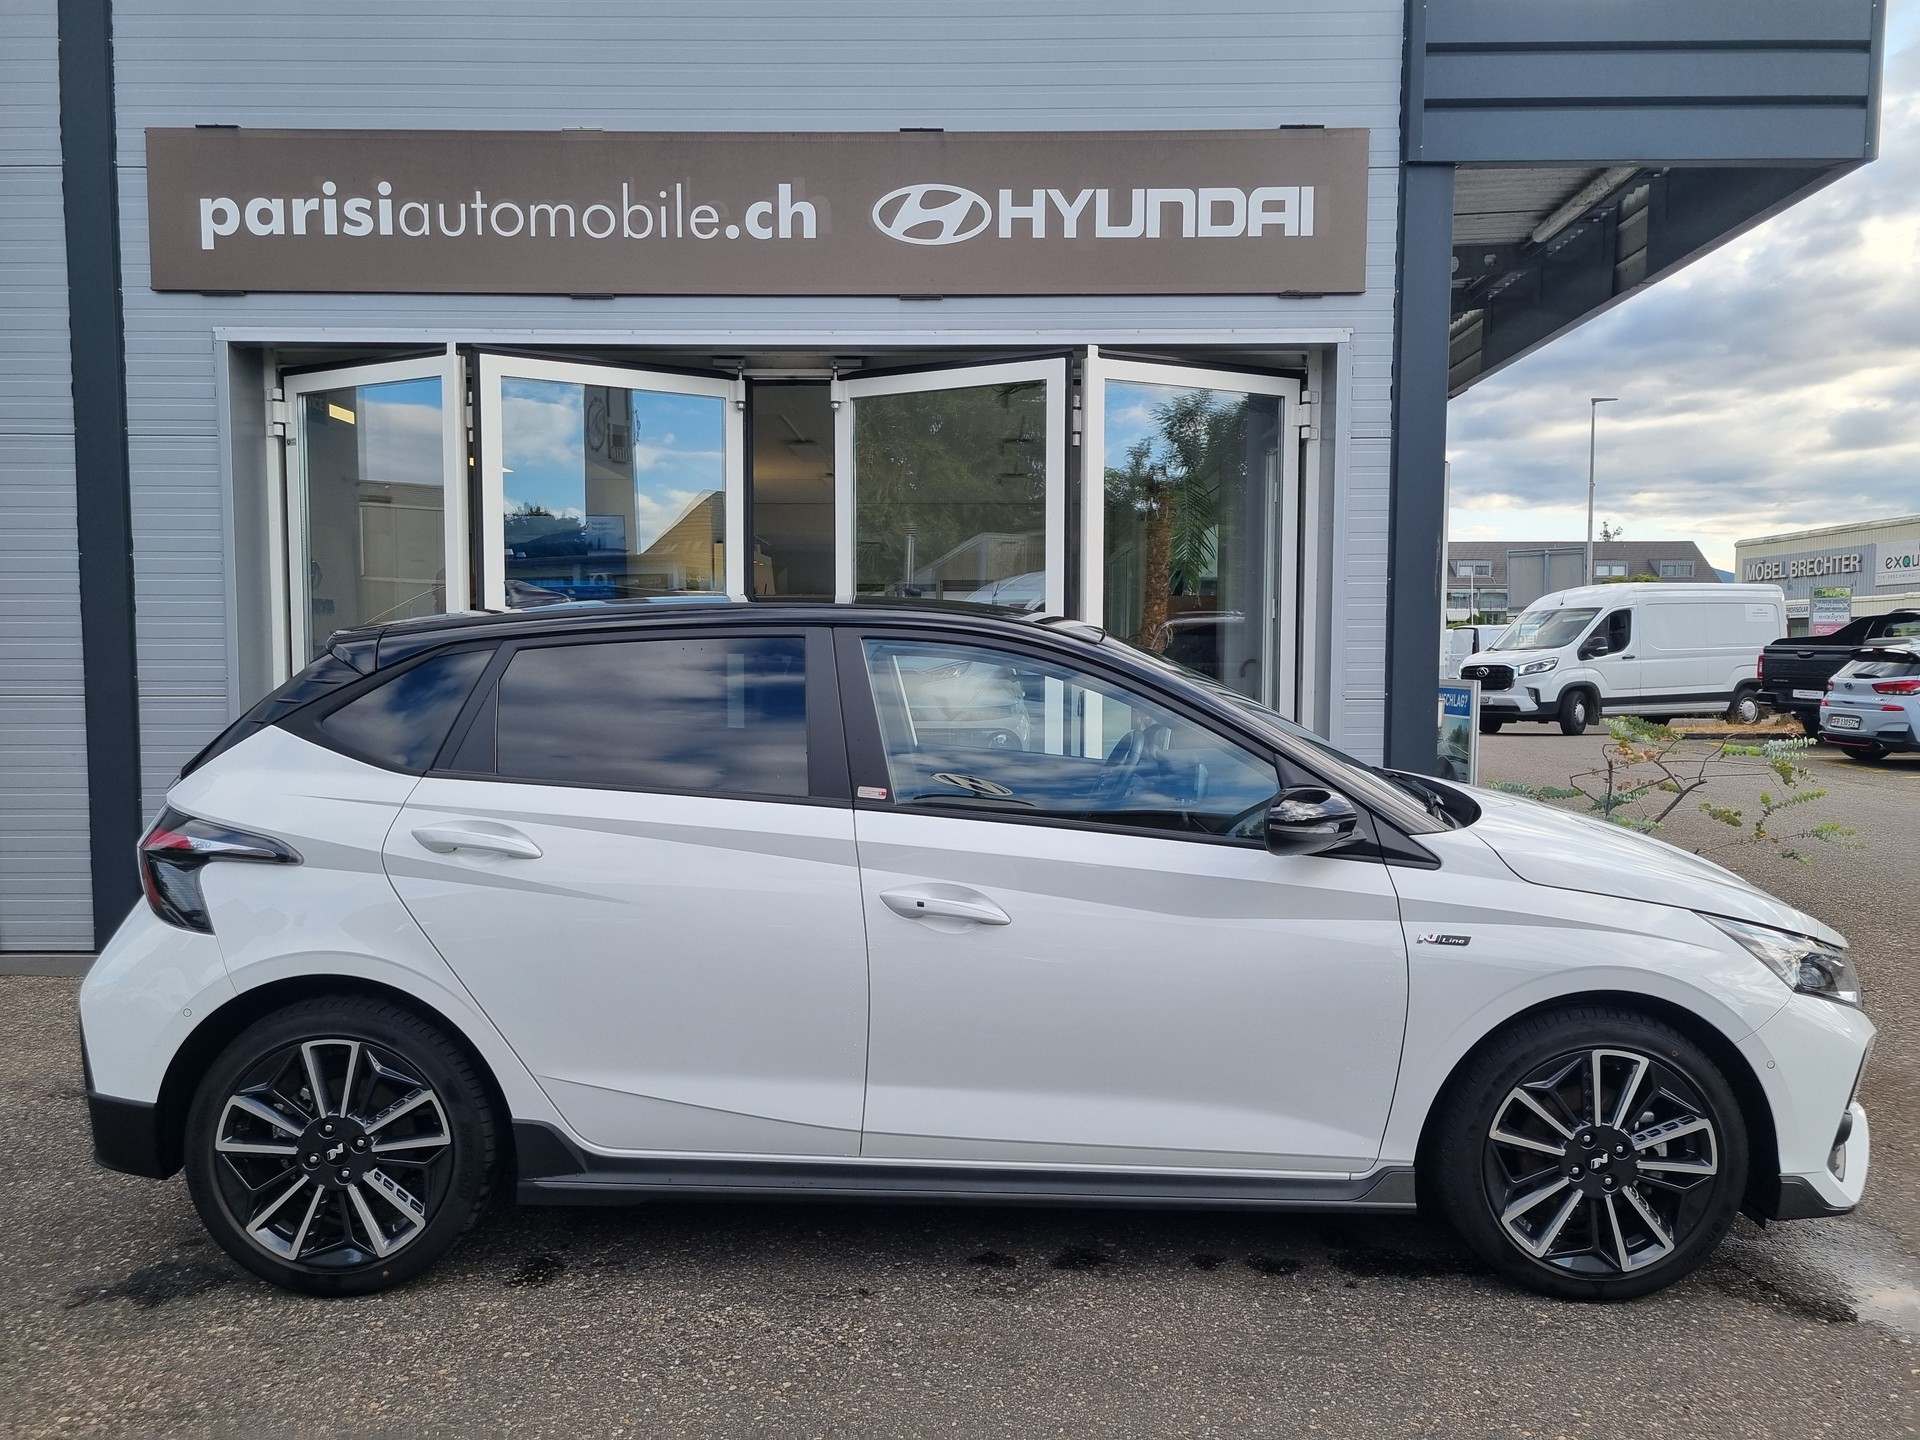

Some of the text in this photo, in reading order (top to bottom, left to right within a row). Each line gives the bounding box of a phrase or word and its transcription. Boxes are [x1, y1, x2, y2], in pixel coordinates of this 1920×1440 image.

[200, 181, 817, 250] parisiautomobile.ch
[999, 186, 1314, 238] HYUNDAI
[1745, 553, 1863, 582] MÖBEL BRECHTER
